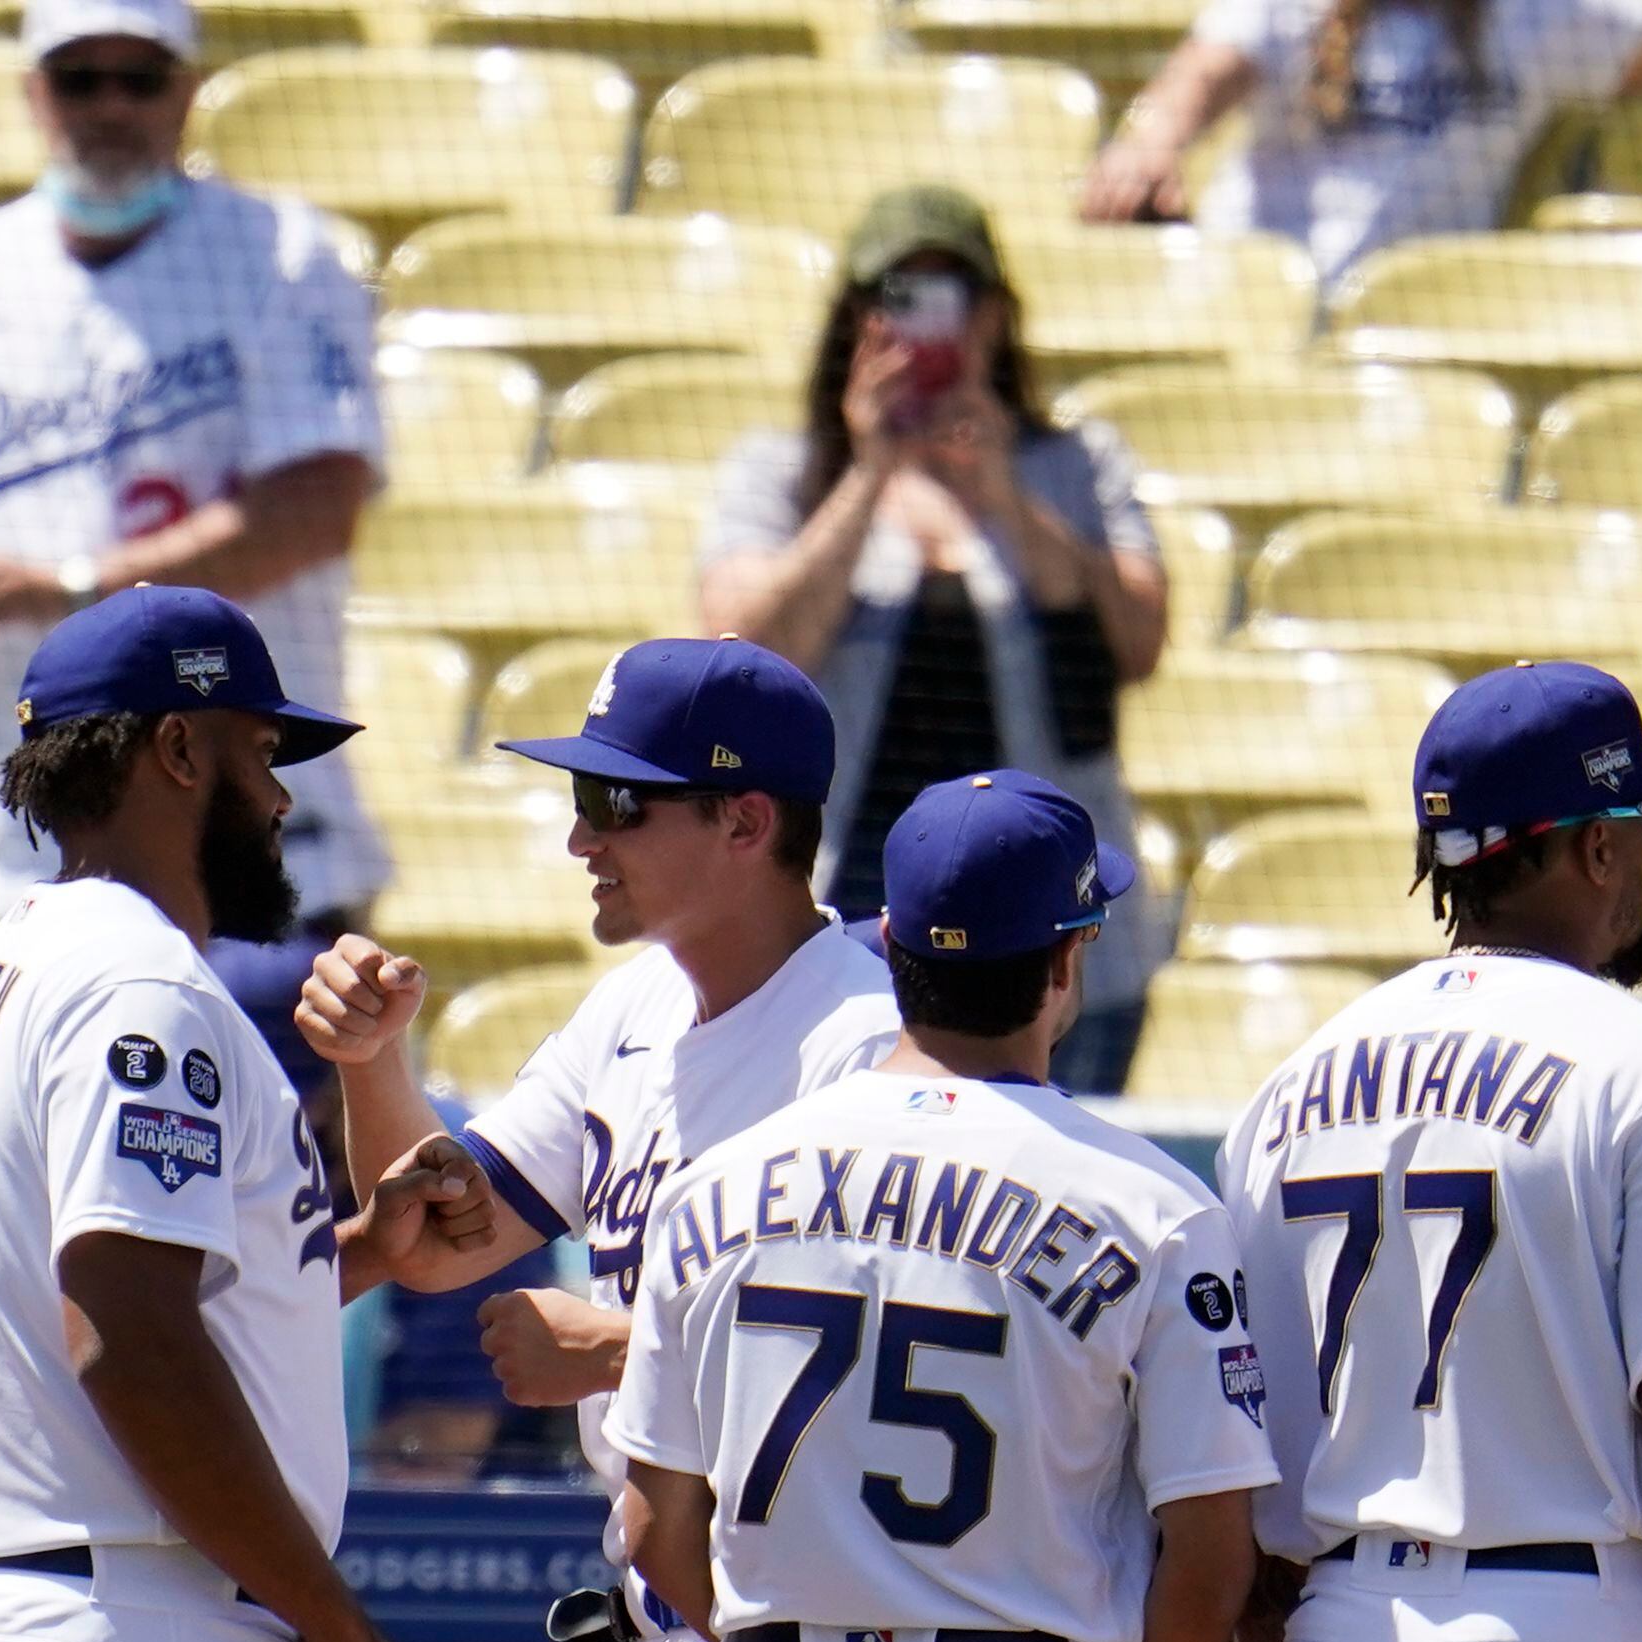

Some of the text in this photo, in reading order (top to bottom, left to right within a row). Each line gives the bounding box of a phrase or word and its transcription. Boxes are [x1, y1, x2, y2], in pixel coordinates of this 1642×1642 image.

[117, 1041, 156, 1052] TOMMY
[126, 1051, 147, 1079] 2
[190, 1067, 215, 1101] 20
[1265, 1030, 1576, 1154] SANTANA
[123, 1127, 217, 1166] CHAMPIONS
[124, 1115, 217, 1145] WORLD SERIES
[161, 1155, 181, 1185] LA
[667, 1146, 1141, 1342] ALEXANDER
[1203, 1291, 1223, 1320] 2
[1281, 1169, 1499, 1416] 77
[733, 1283, 1009, 1549] 75
[336, 1549, 615, 1592] ODGERS.CO
